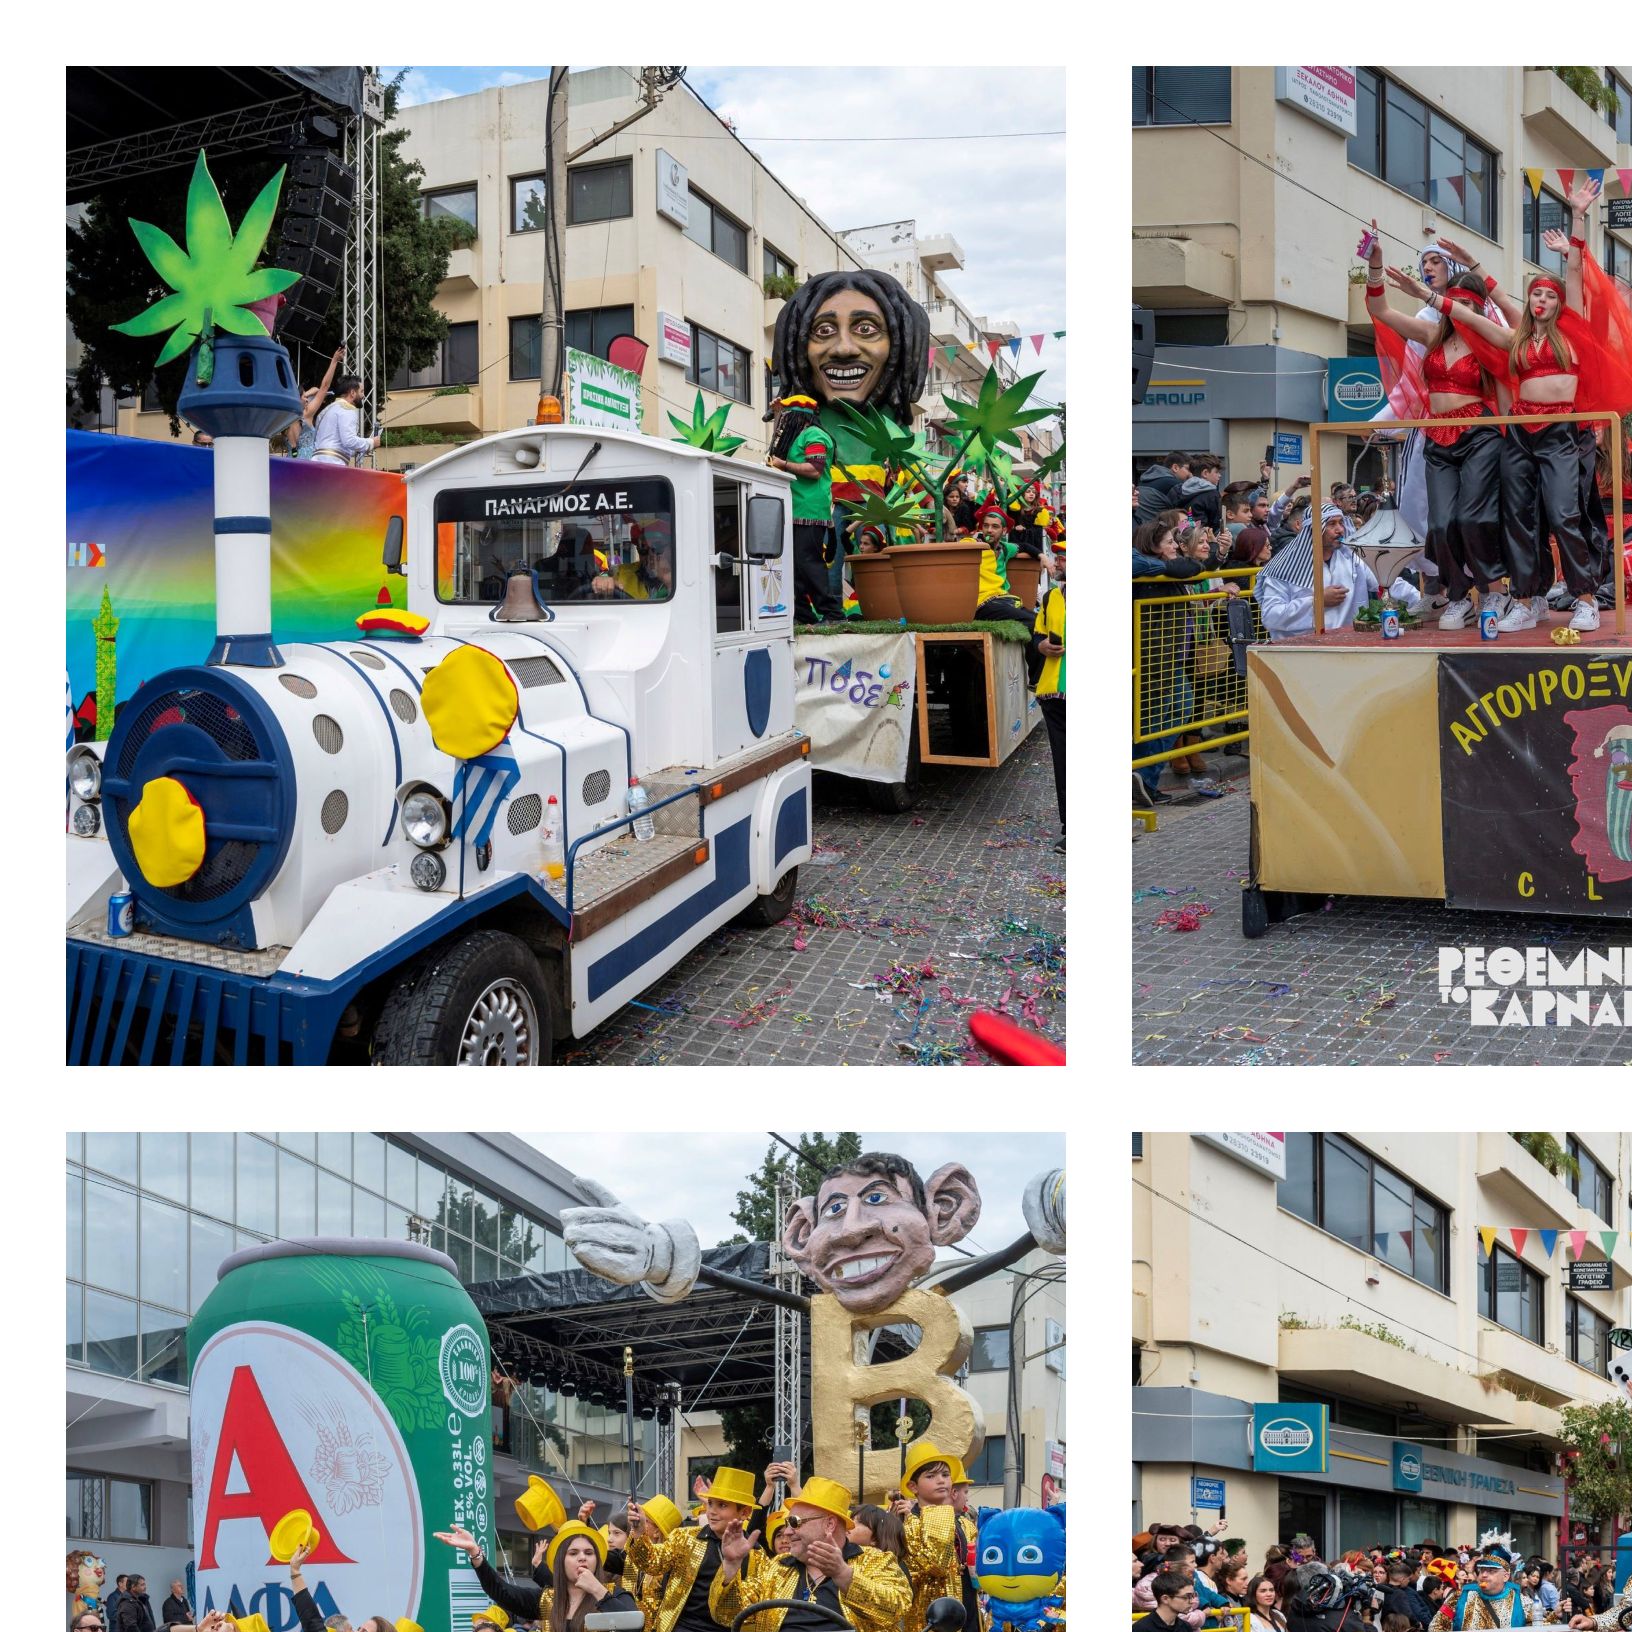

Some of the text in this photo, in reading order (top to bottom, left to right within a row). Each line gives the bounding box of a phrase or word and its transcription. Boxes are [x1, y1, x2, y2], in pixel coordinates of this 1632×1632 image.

[1327, 88, 1348, 107] ΑΘΗΝΑ
[1144, 392, 1206, 406] GROUP
[485, 491, 633, 516] ΠΑΝΑΡΜΟΣ Α.Ε.
[464, 1444, 473, 1488] VOL.
[1422, 1463, 1517, 1496] ΕΘΝΙΚΗ ΤΡΑΠΕΖΑ
